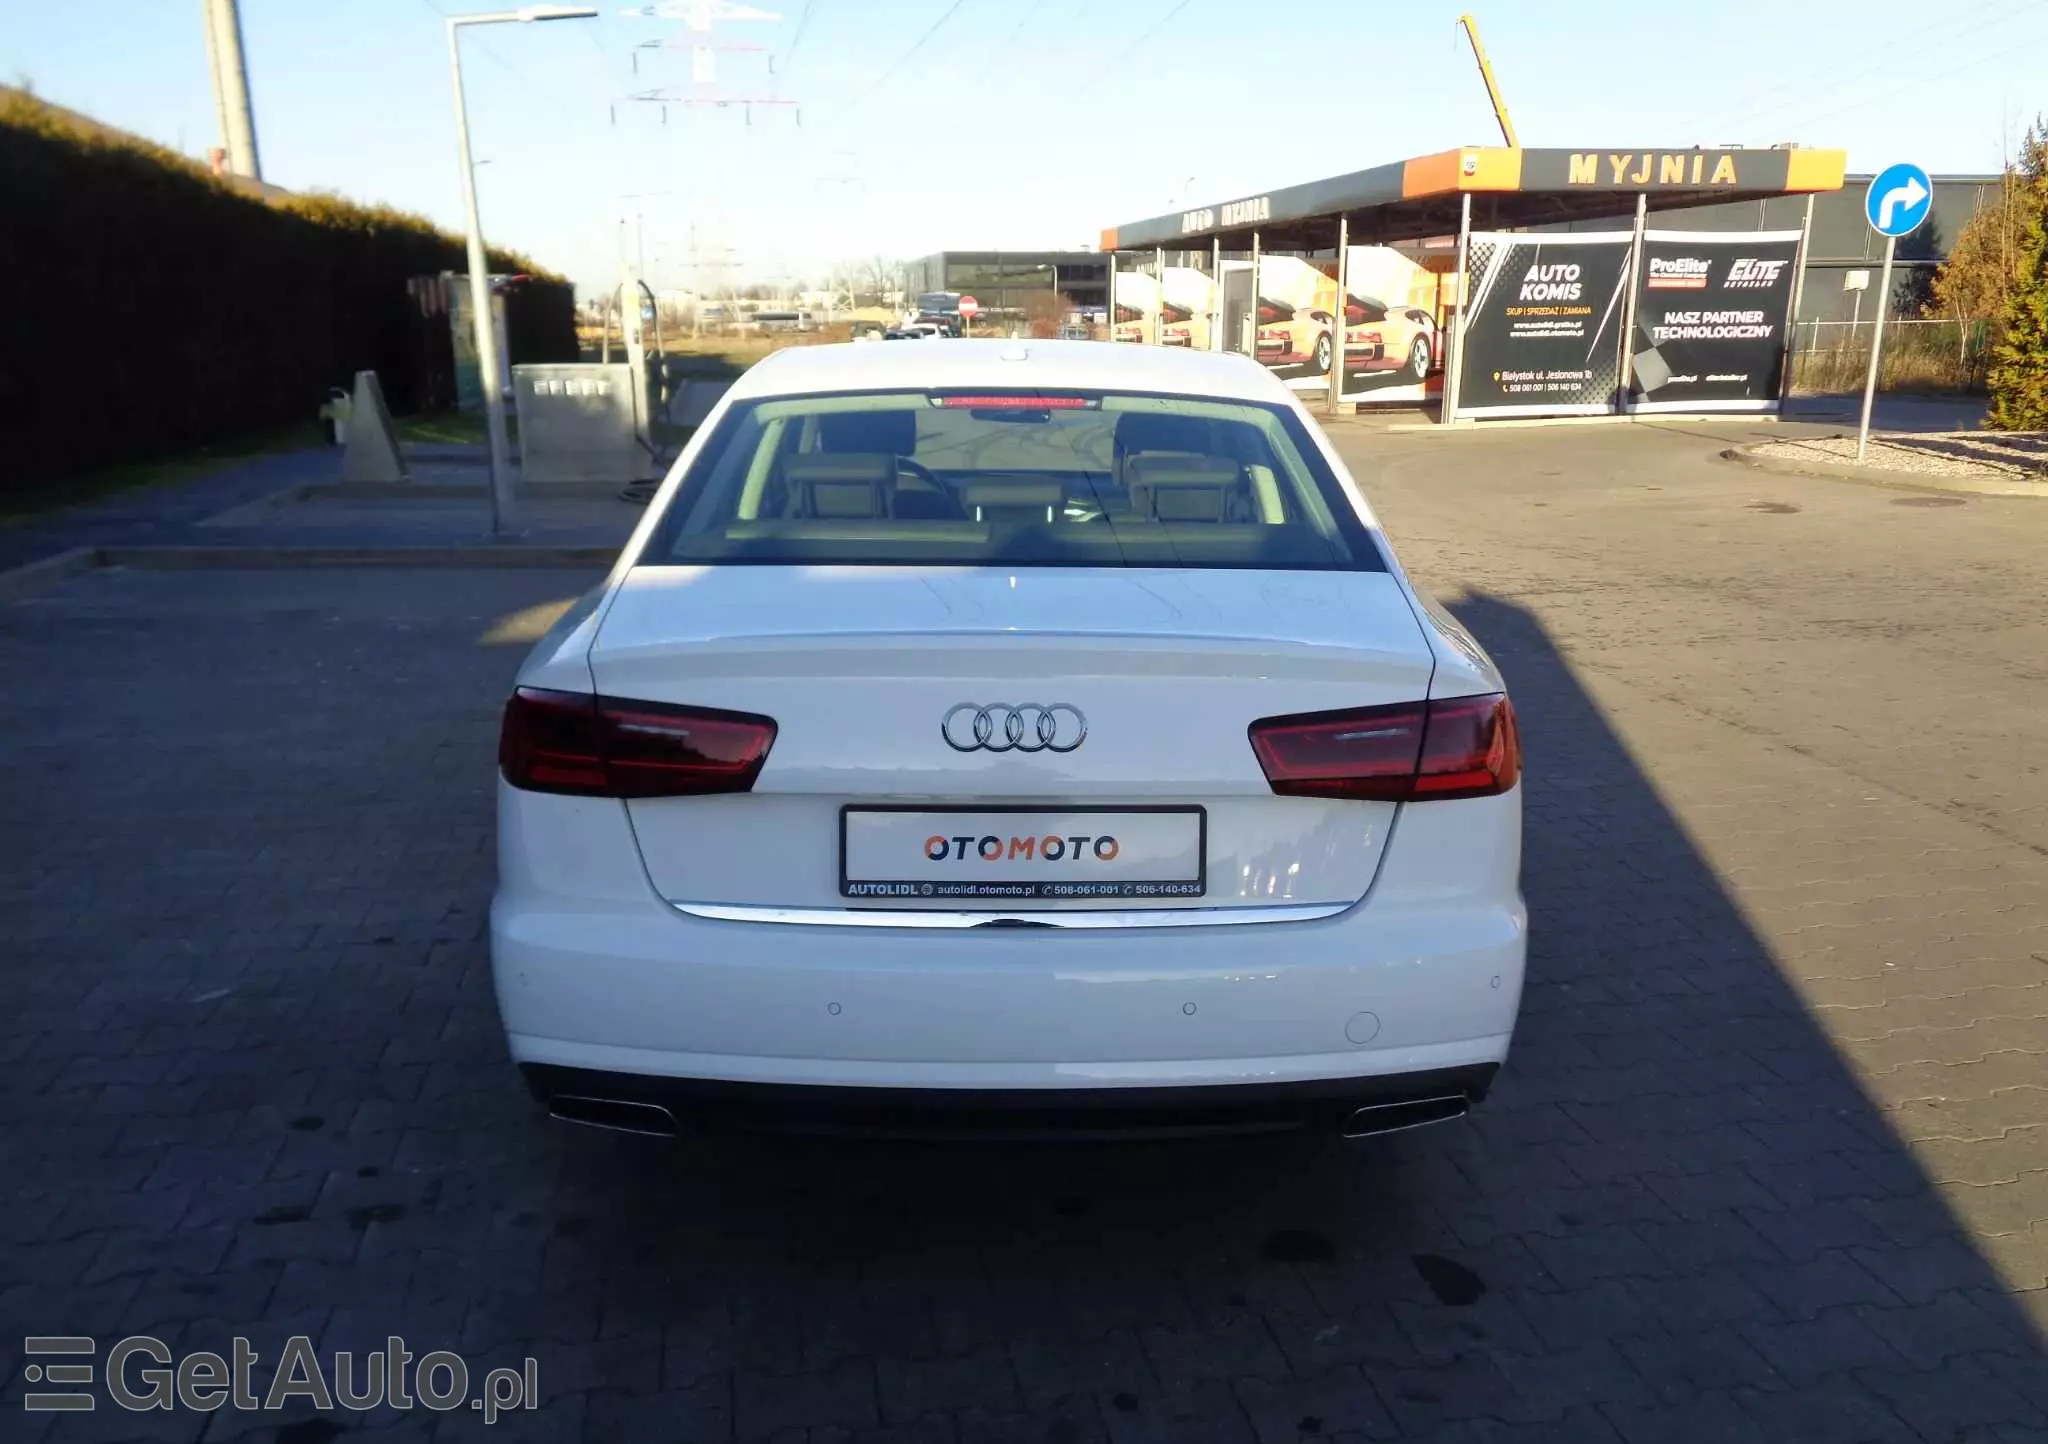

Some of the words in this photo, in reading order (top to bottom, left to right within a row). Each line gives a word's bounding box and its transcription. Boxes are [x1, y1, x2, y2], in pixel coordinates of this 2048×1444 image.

[1568, 153, 1737, 185] MYJNIA
[1523, 264, 1581, 282] AUTO
[1649, 258, 1708, 273] ProElite
[1520, 282, 1583, 300] KOMIS
[1506, 307, 1523, 316] SKUP
[1664, 311, 1701, 324] NASZ
[1702, 311, 1764, 323] PARTNER
[1652, 325, 1774, 339] TECHNOLOGICZNY
[924, 835, 1119, 861] OTOMOTO
[848, 884, 918, 895] AUTOLIDL
[937, 884, 1035, 897] autolidl.otomoto.pl
[1135, 884, 1201, 894] 506-140-634
